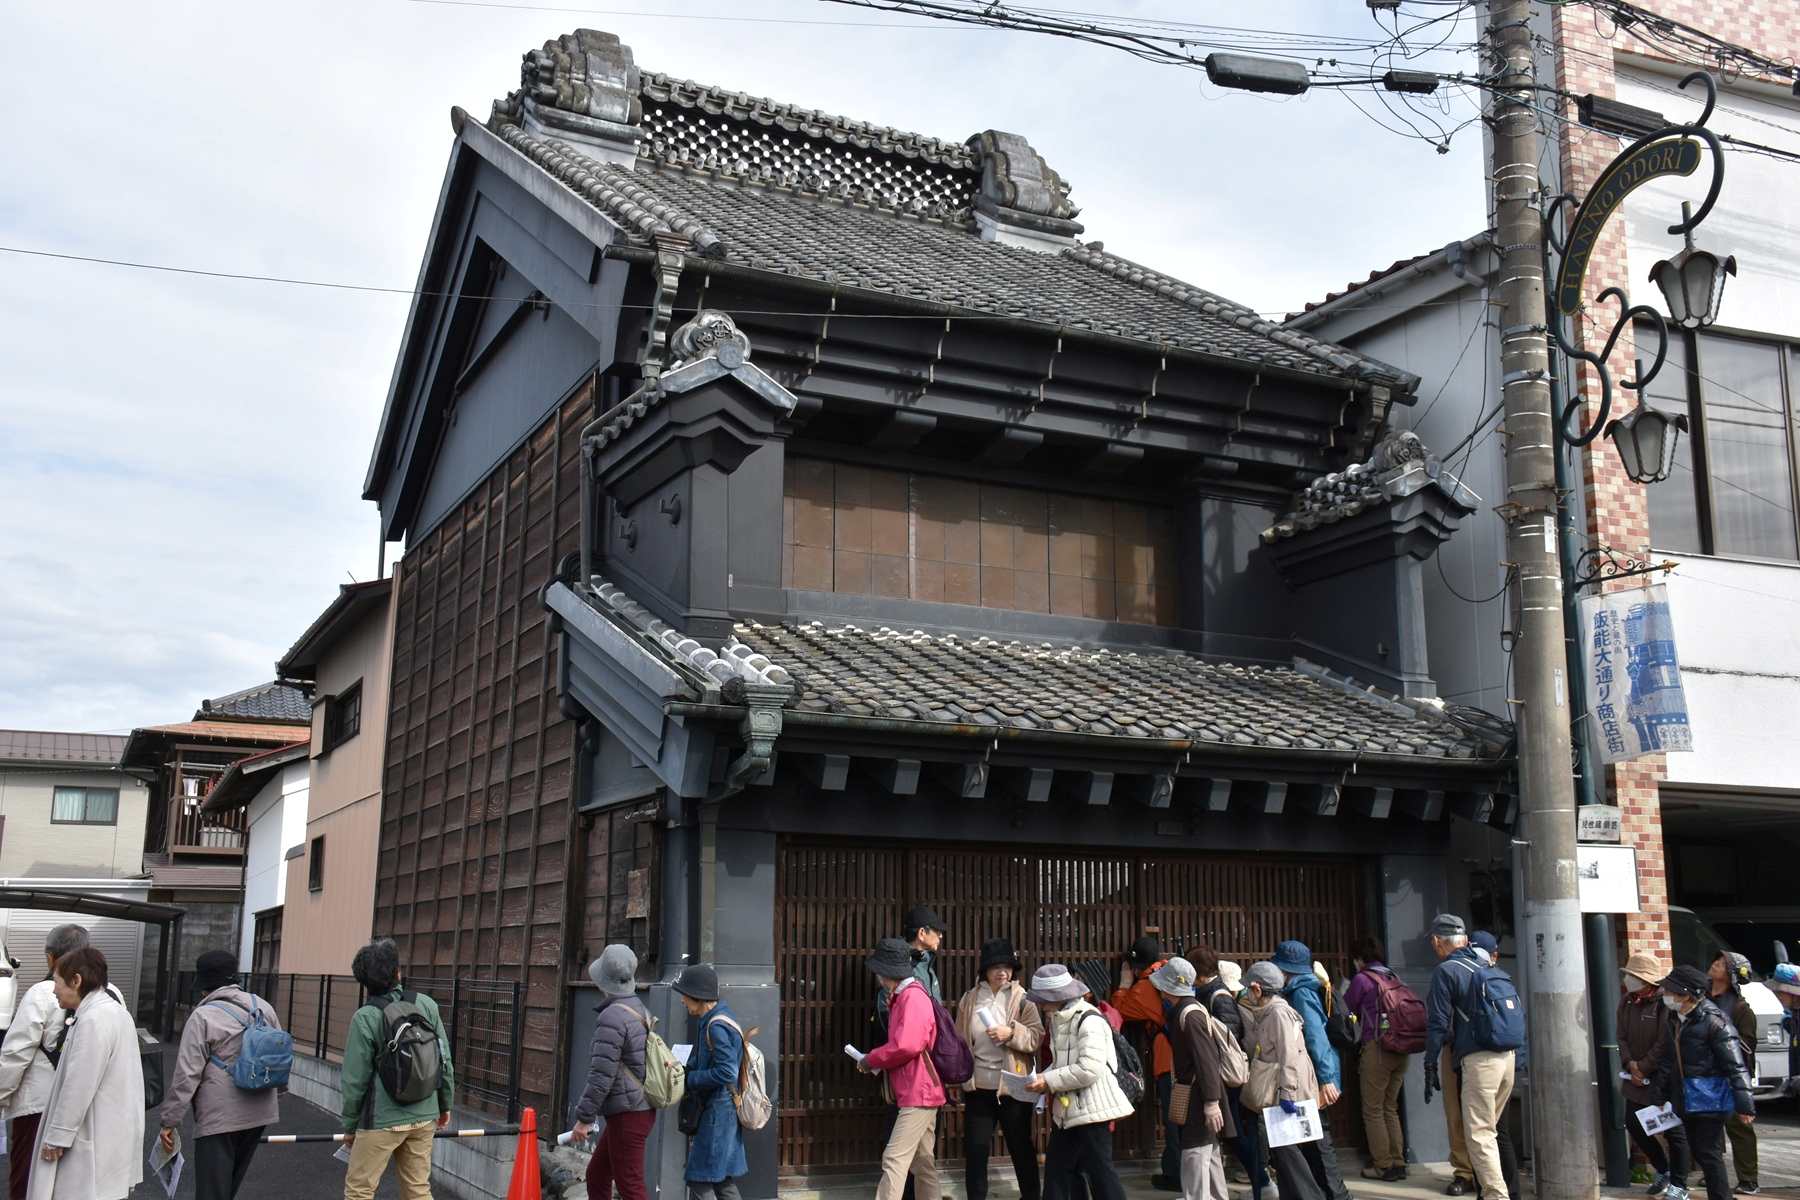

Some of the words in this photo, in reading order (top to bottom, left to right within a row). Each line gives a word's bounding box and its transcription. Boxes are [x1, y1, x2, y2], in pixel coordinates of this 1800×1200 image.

[1565, 190, 1615, 289] HANNO
[1593, 610, 1625, 754] 飯能大通り商店街
